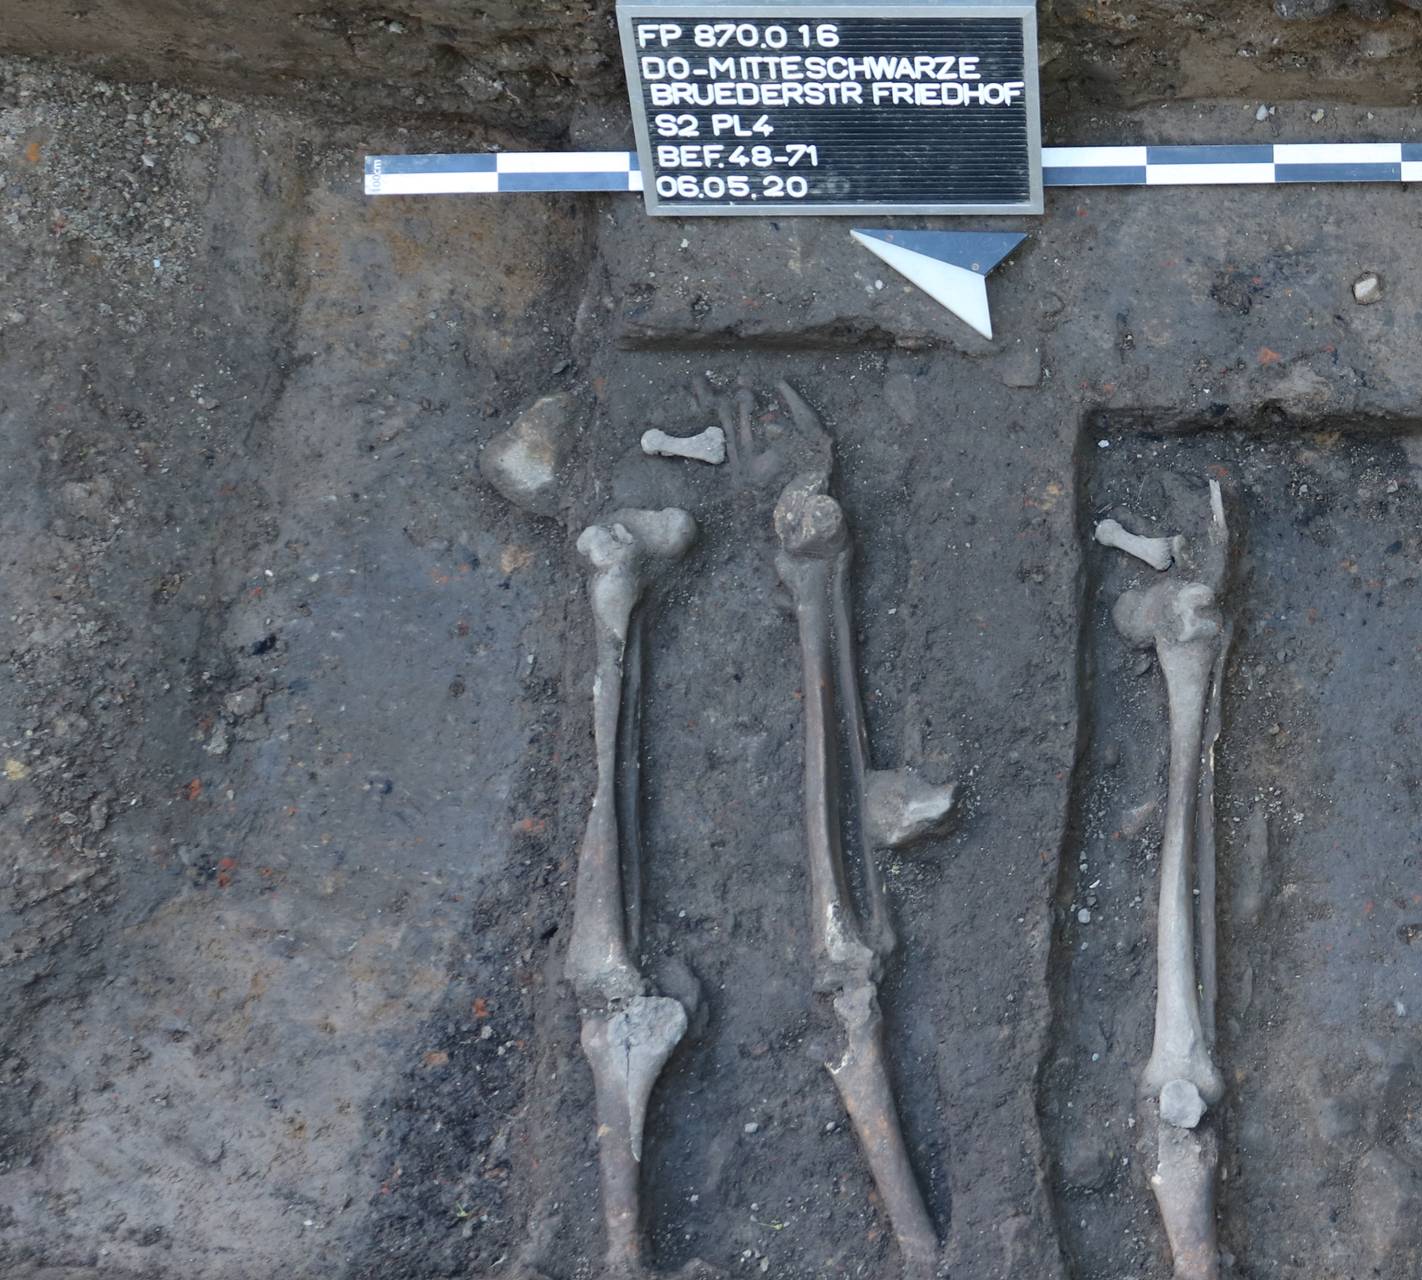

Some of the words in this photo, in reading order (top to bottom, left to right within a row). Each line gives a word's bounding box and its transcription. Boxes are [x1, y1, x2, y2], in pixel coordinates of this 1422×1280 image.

[637, 24, 682, 49] FP
[650, 82, 862, 106] BRUEDERSTR
[872, 81, 1025, 107] FRIEDHOF
[655, 114, 700, 137] S2
[711, 114, 774, 137] PL4
[656, 175, 808, 200] 06.05.20
